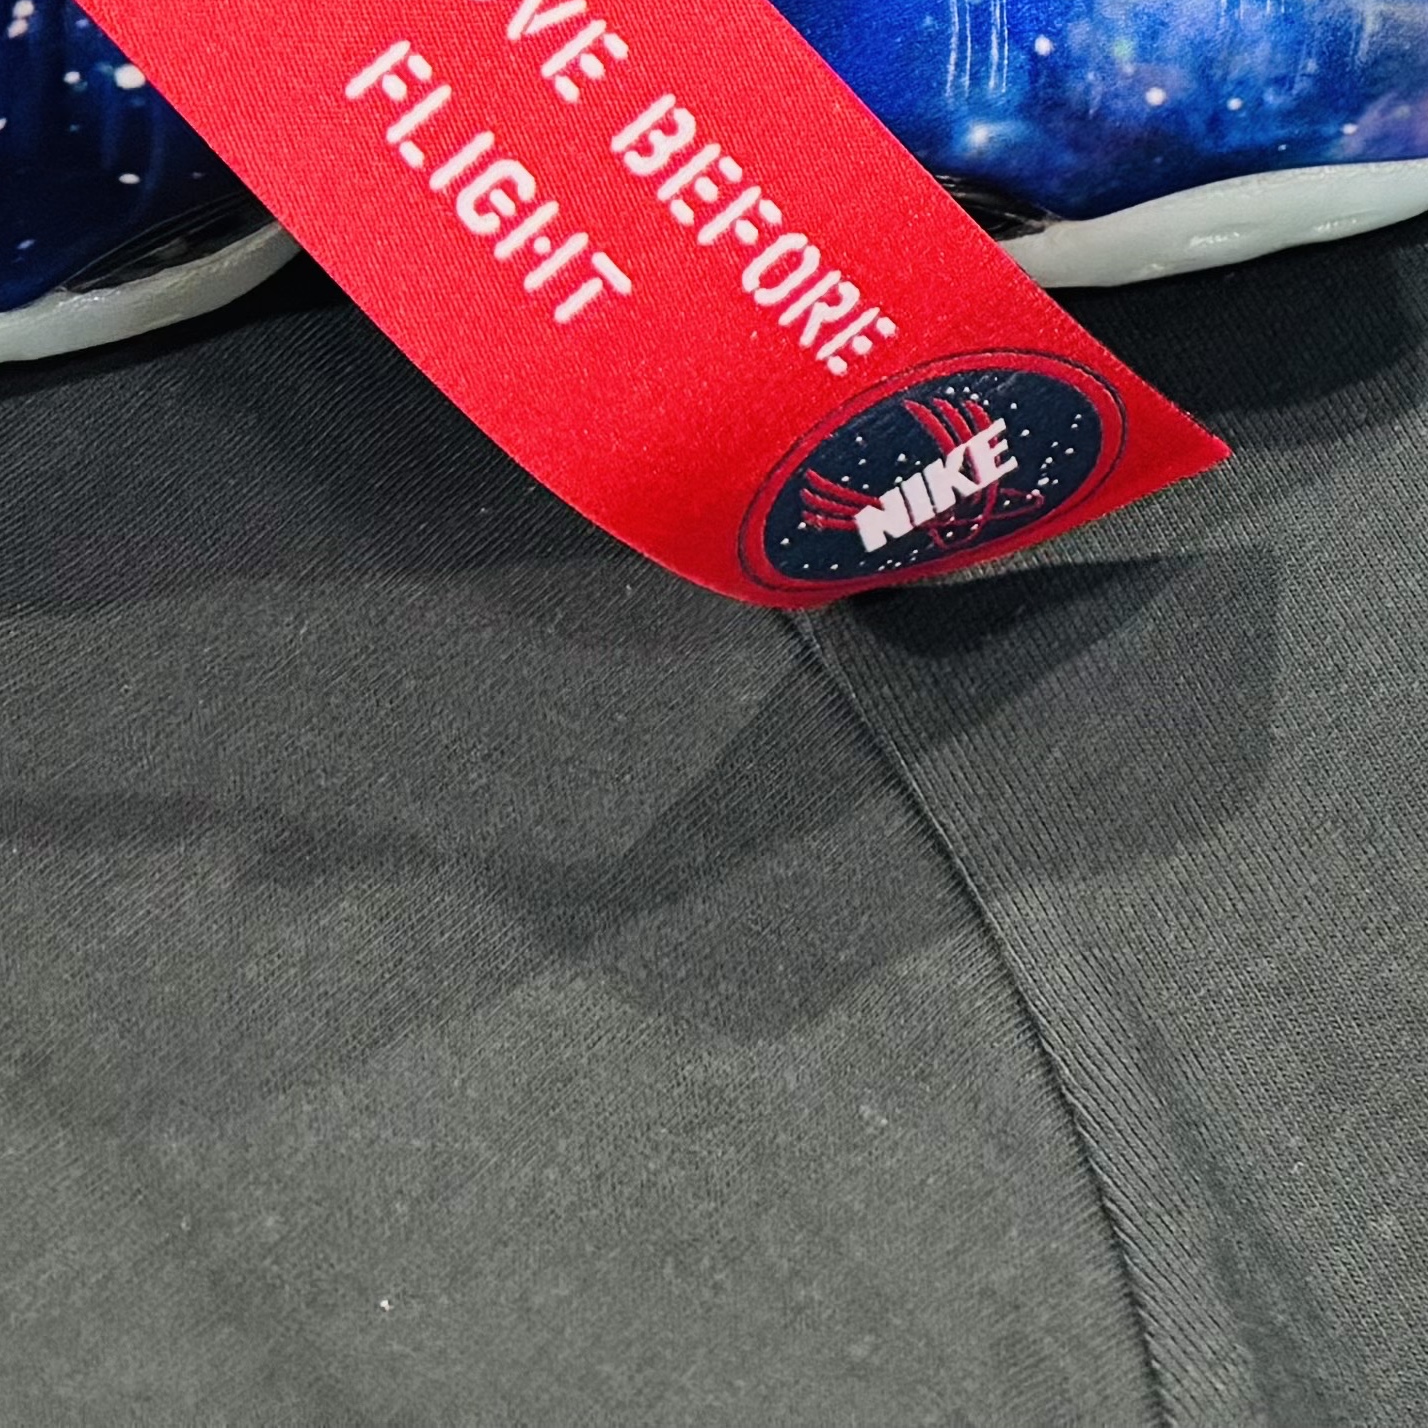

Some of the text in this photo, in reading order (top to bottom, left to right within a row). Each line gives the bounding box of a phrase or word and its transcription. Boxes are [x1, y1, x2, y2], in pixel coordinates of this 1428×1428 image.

[344, 40, 633, 326] FLIGHT
[611, 93, 900, 376] BEFORE
[851, 419, 1018, 553] NIKE
